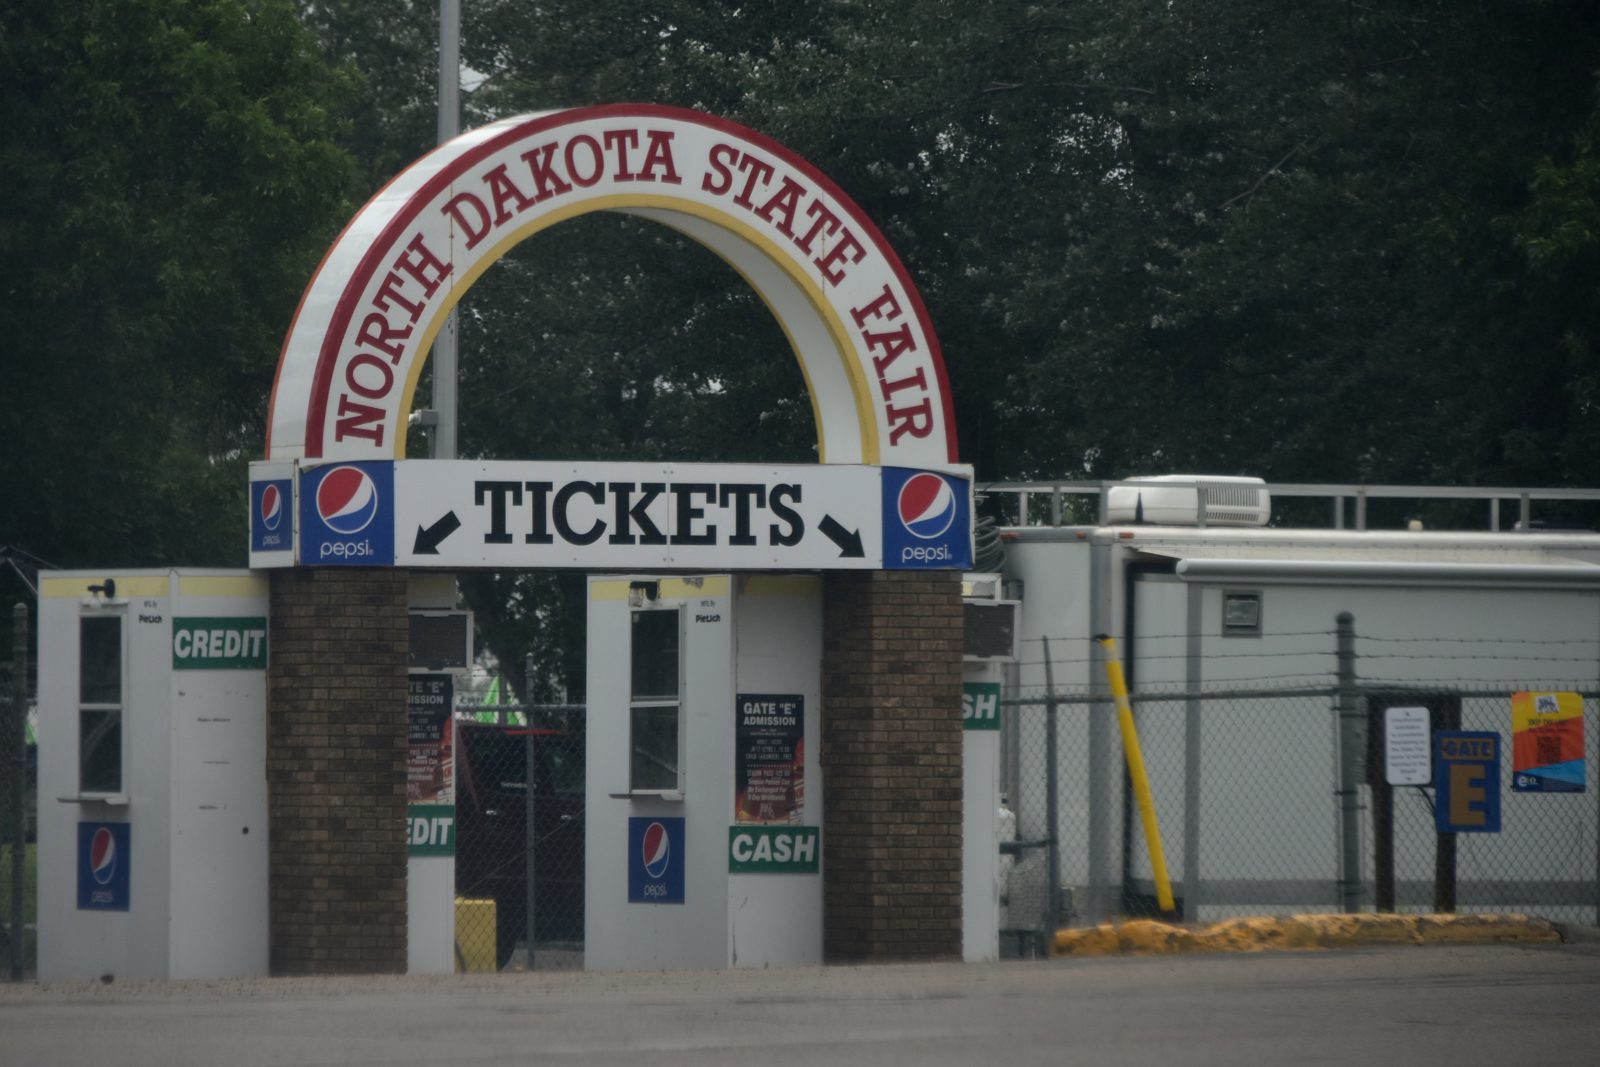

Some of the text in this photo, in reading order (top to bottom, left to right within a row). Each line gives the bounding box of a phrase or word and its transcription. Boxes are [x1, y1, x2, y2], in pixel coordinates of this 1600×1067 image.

[335, 129, 935, 447] NORTH DAKOTA STATE FAIR
[474, 480, 805, 547] TICKETS
[320, 539, 369, 559] pepsi
[902, 544, 948, 564] pepsi
[174, 629, 266, 658] CREDIT
[743, 702, 796, 715] GATE "E"
[743, 716, 796, 726] ADMISSION
[1447, 741, 1490, 756] GATE
[1450, 764, 1486, 825] E
[732, 834, 815, 862] CASH
